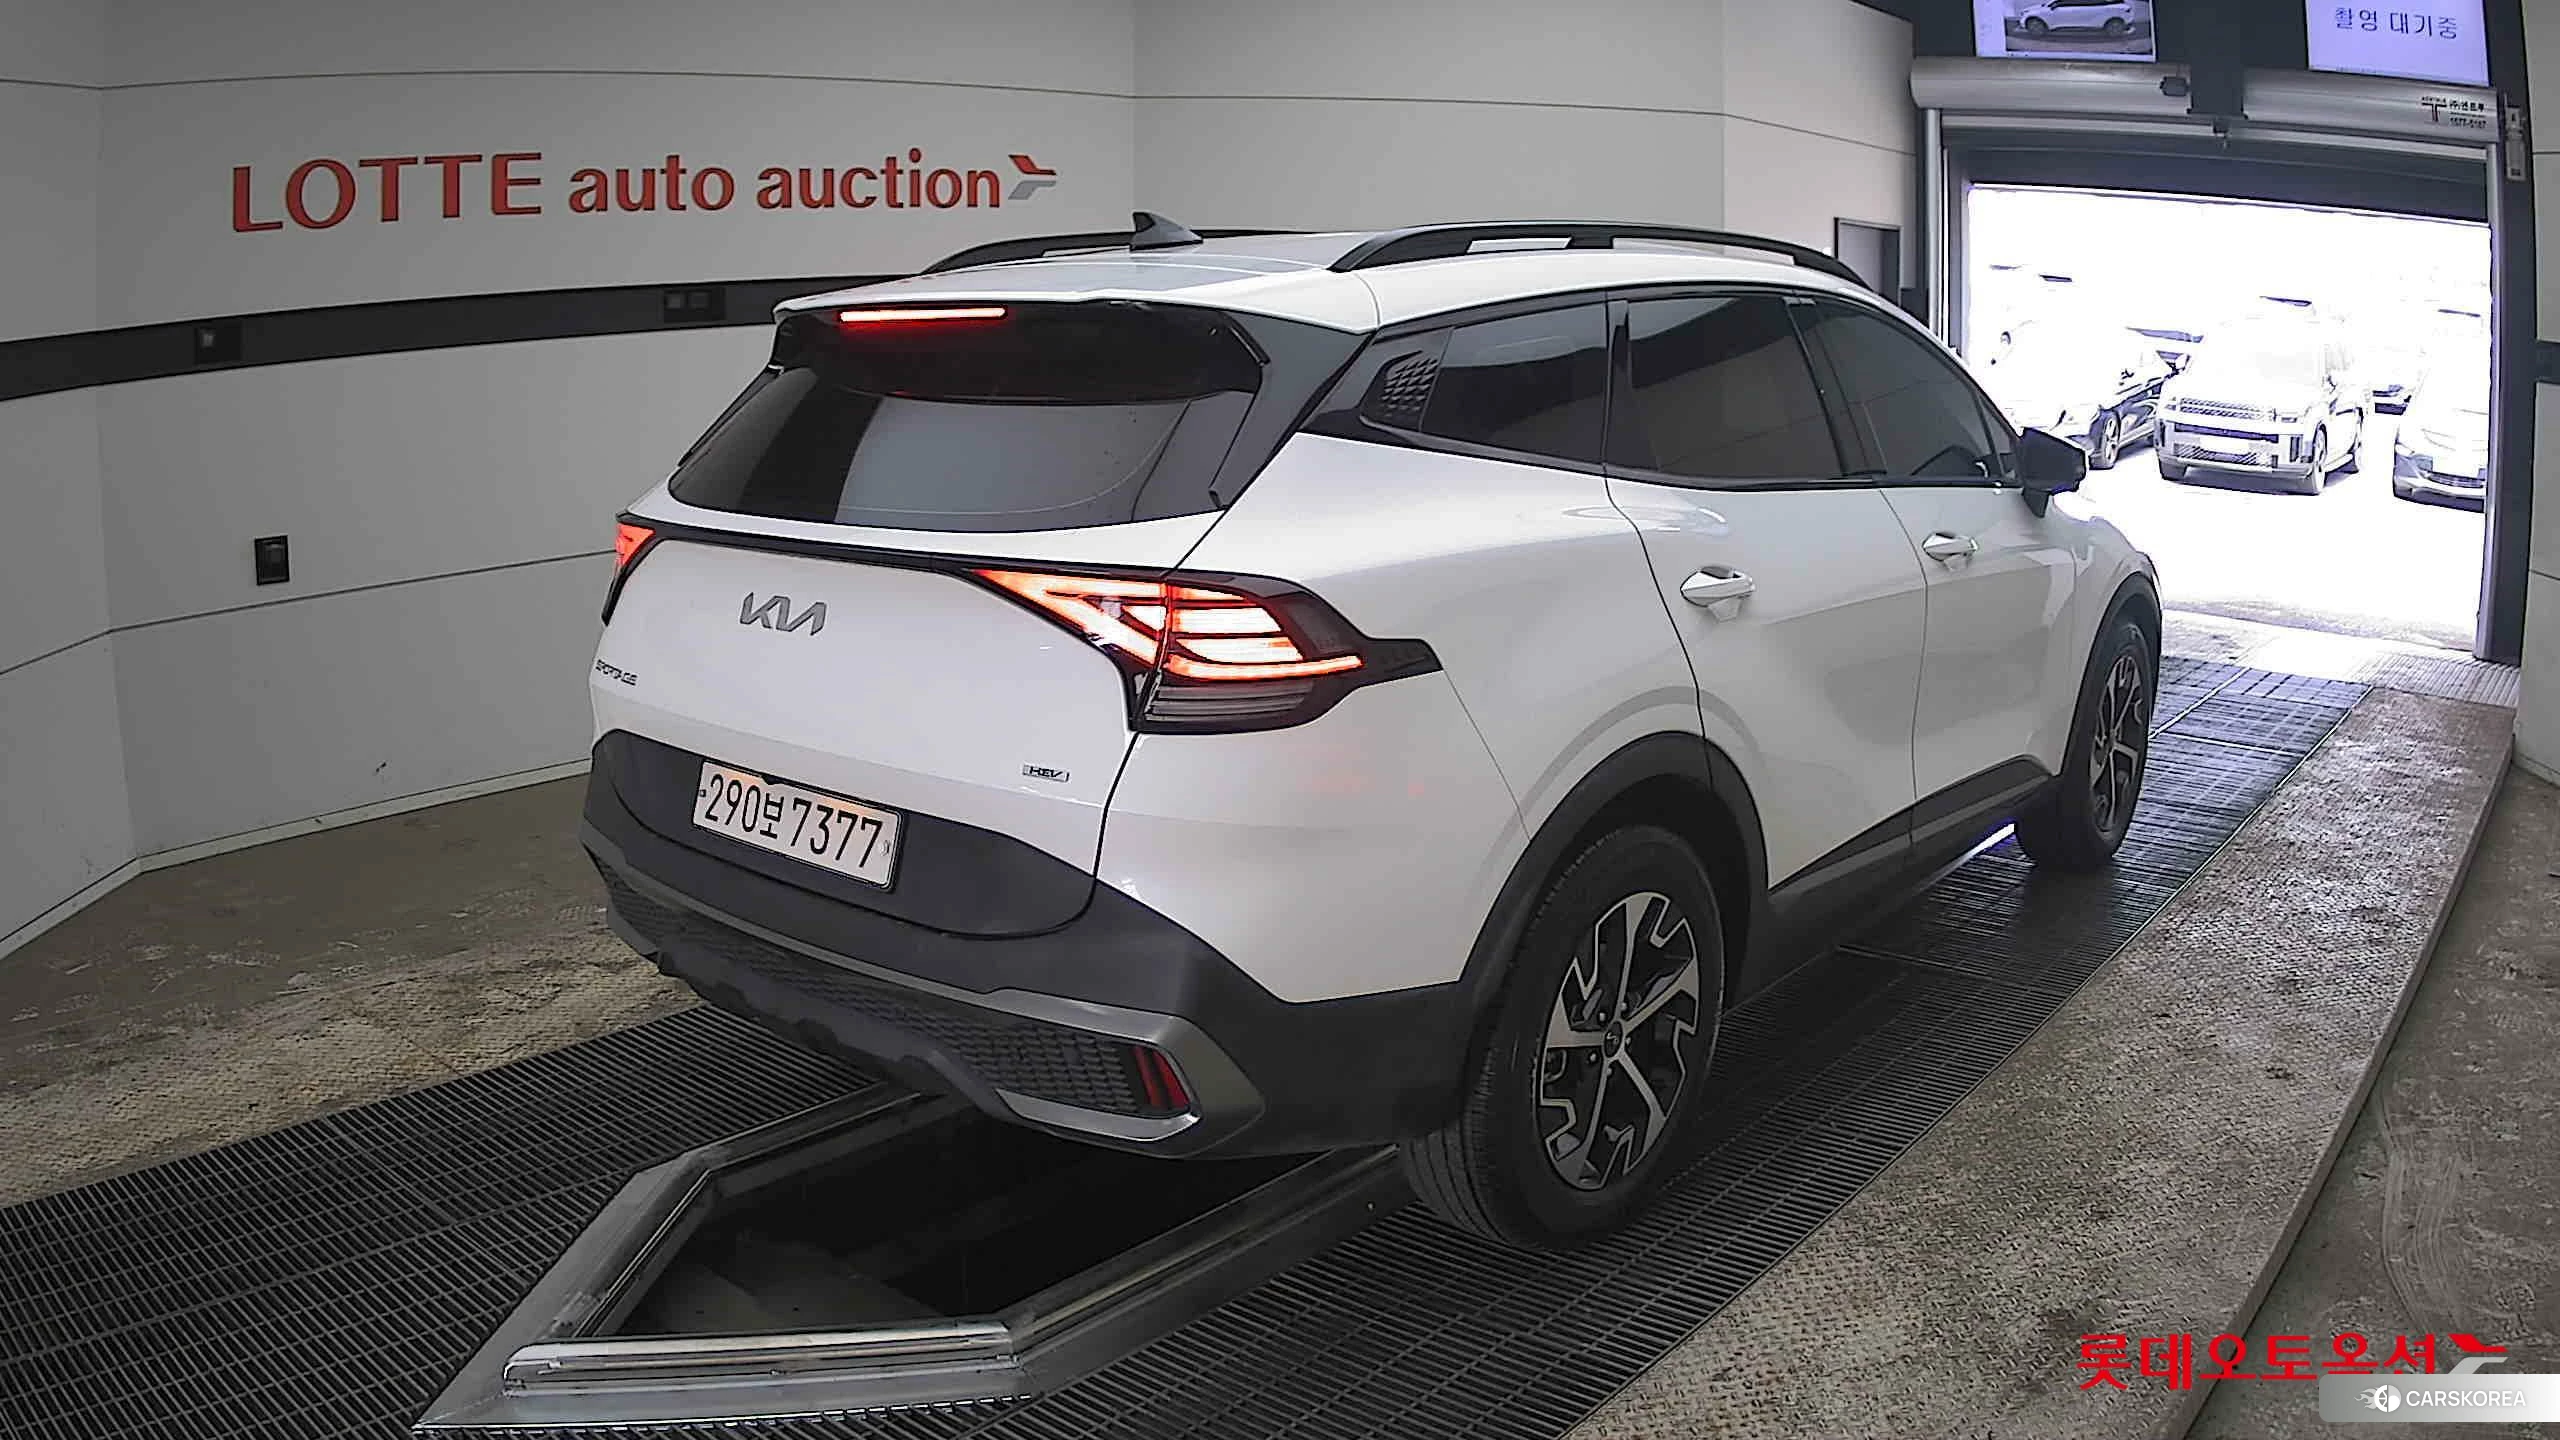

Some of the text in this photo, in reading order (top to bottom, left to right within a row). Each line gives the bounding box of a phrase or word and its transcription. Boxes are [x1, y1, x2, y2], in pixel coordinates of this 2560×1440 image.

[2335, 7, 2457, 40] 촬영 대기중
[233, 148, 1001, 232] LOTTE auto auction
[740, 592, 827, 636] KIA
[1029, 765, 1064, 779] HEV
